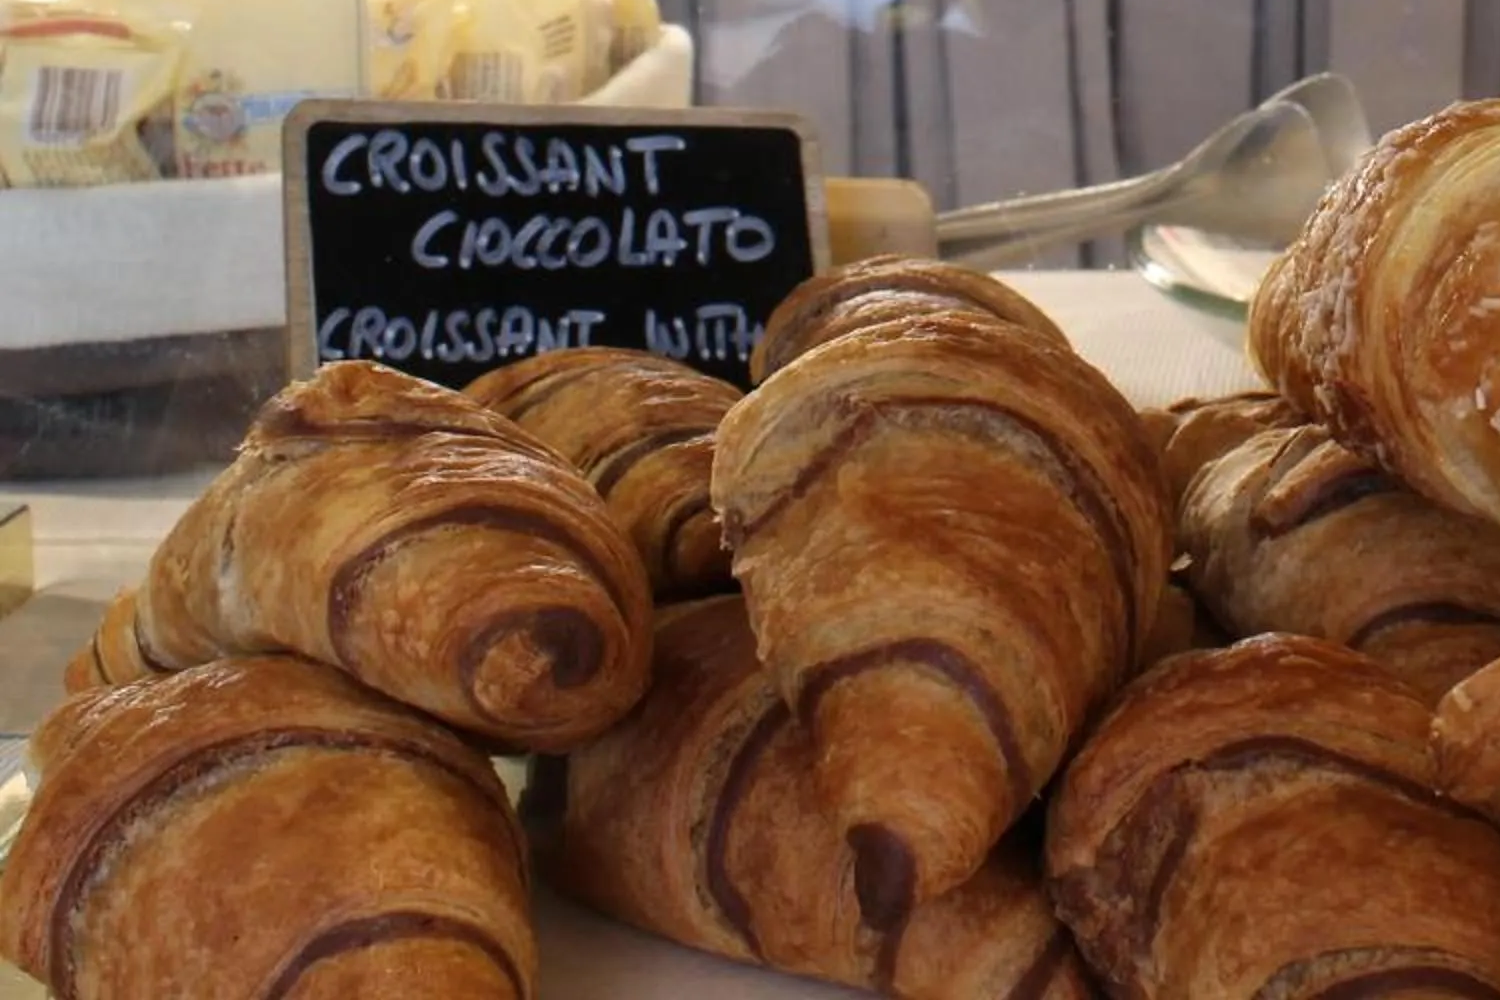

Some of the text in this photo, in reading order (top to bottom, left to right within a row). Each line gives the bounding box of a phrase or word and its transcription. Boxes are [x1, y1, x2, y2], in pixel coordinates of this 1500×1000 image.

[322, 131, 685, 195] CROISSANT
[411, 208, 775, 268] CIOCCOLATO
[318, 306, 605, 361] CROISSANT
